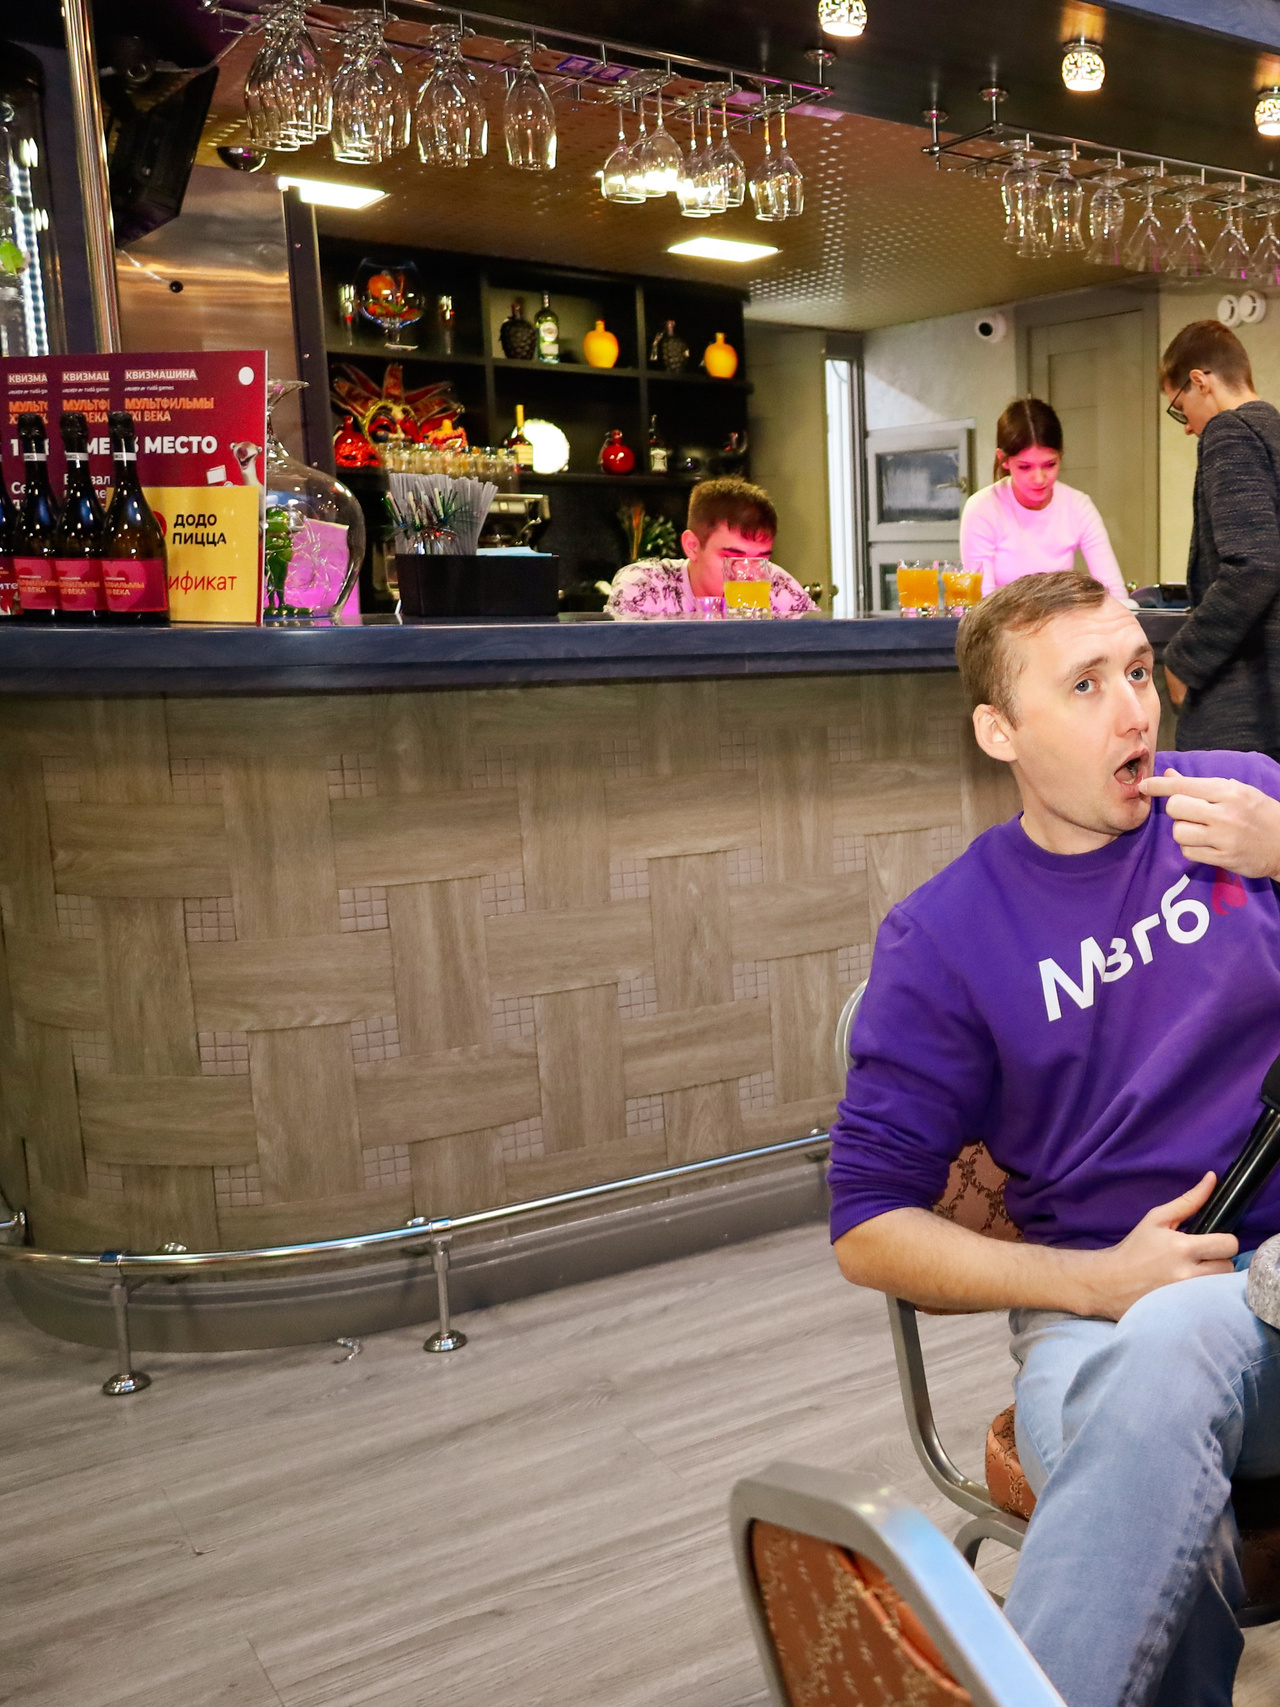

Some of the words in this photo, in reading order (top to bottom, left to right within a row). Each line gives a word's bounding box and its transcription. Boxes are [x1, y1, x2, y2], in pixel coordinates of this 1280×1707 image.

[125, 368, 198, 380] КВИЗМАШИНА
[125, 397, 214, 409] МУЛЬТФИЛЬМЫ
[144, 411, 171, 421] ВЕКА
[144, 435, 218, 454] МЕСТО
[173, 513, 217, 529] ДОДО
[172, 532, 227, 547] ПИЦЦА
